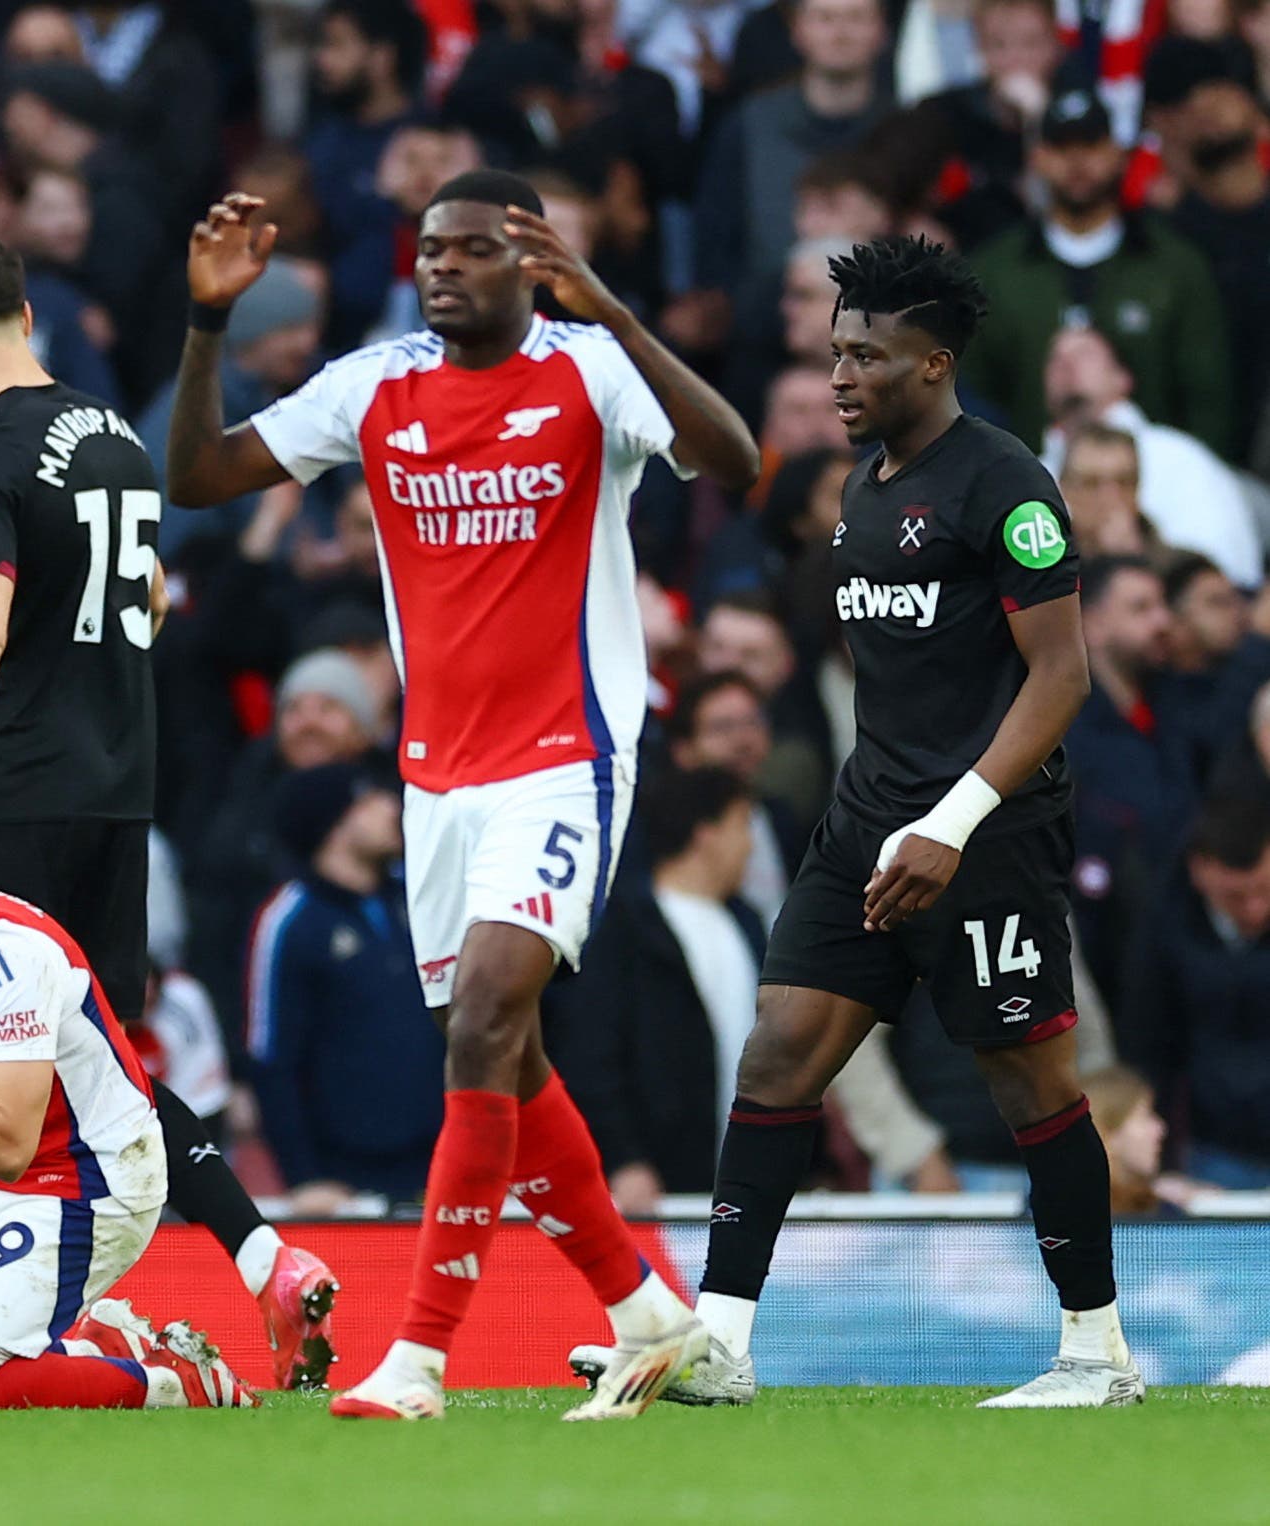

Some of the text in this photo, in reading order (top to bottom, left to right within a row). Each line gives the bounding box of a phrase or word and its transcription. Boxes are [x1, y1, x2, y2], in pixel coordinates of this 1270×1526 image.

[36, 407, 146, 488] MAVROPAN
[385, 461, 566, 508] Emirates
[415, 506, 536, 546] FLY BETTER
[73, 488, 162, 650] 15
[835, 577, 941, 628] etway
[537, 821, 583, 890] 5
[964, 914, 1042, 987] 14
[1002, 1012, 1030, 1024] umbro
[506, 1176, 551, 1198] FC
